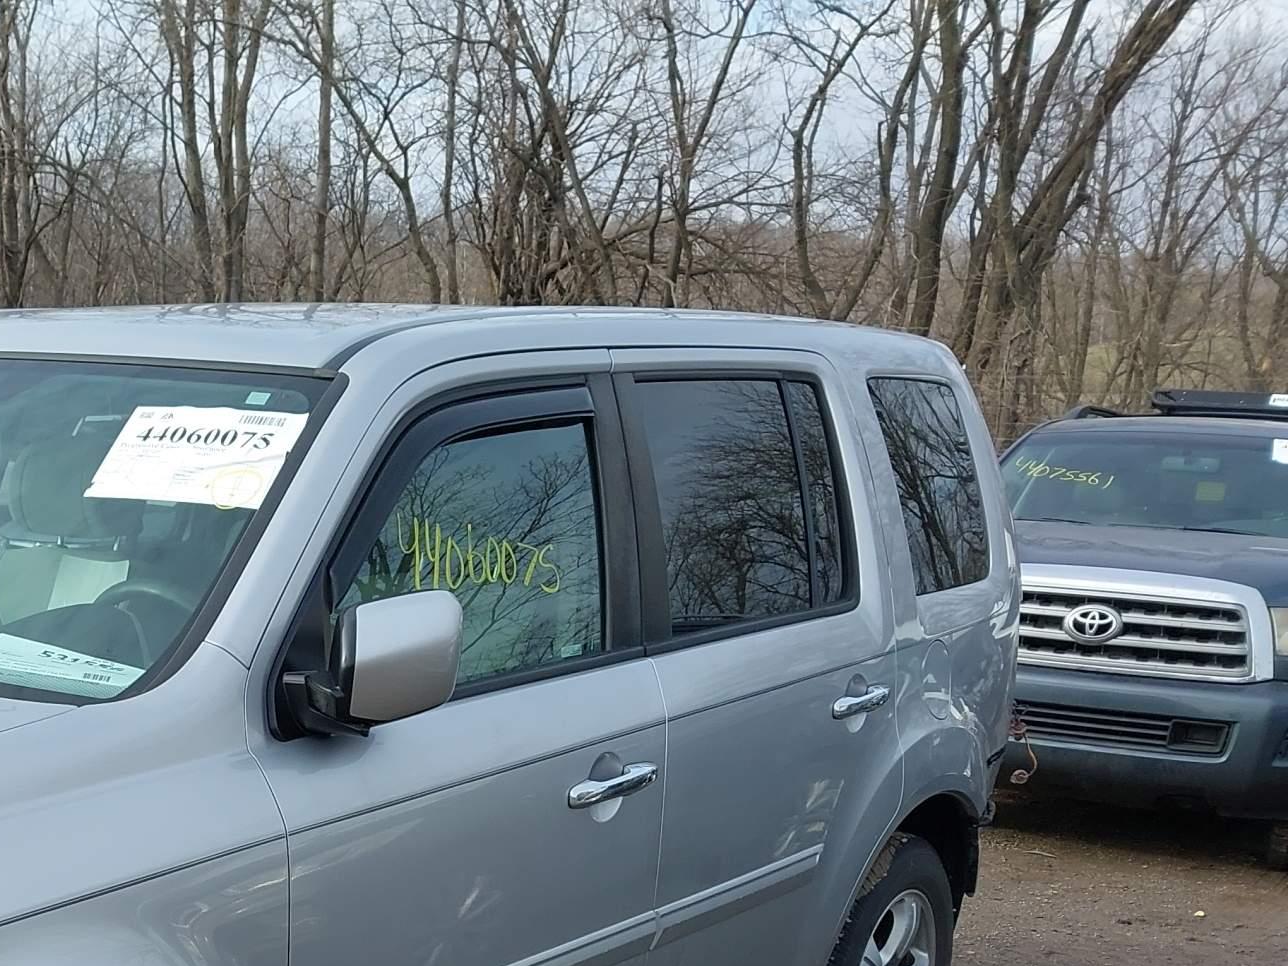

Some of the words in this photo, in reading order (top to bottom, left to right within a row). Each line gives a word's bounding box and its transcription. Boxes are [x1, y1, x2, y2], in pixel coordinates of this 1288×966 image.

[136, 426, 275, 449] 44060075
[1016, 456, 1114, 489] 44075561
[396, 512, 560, 593] 44060075
